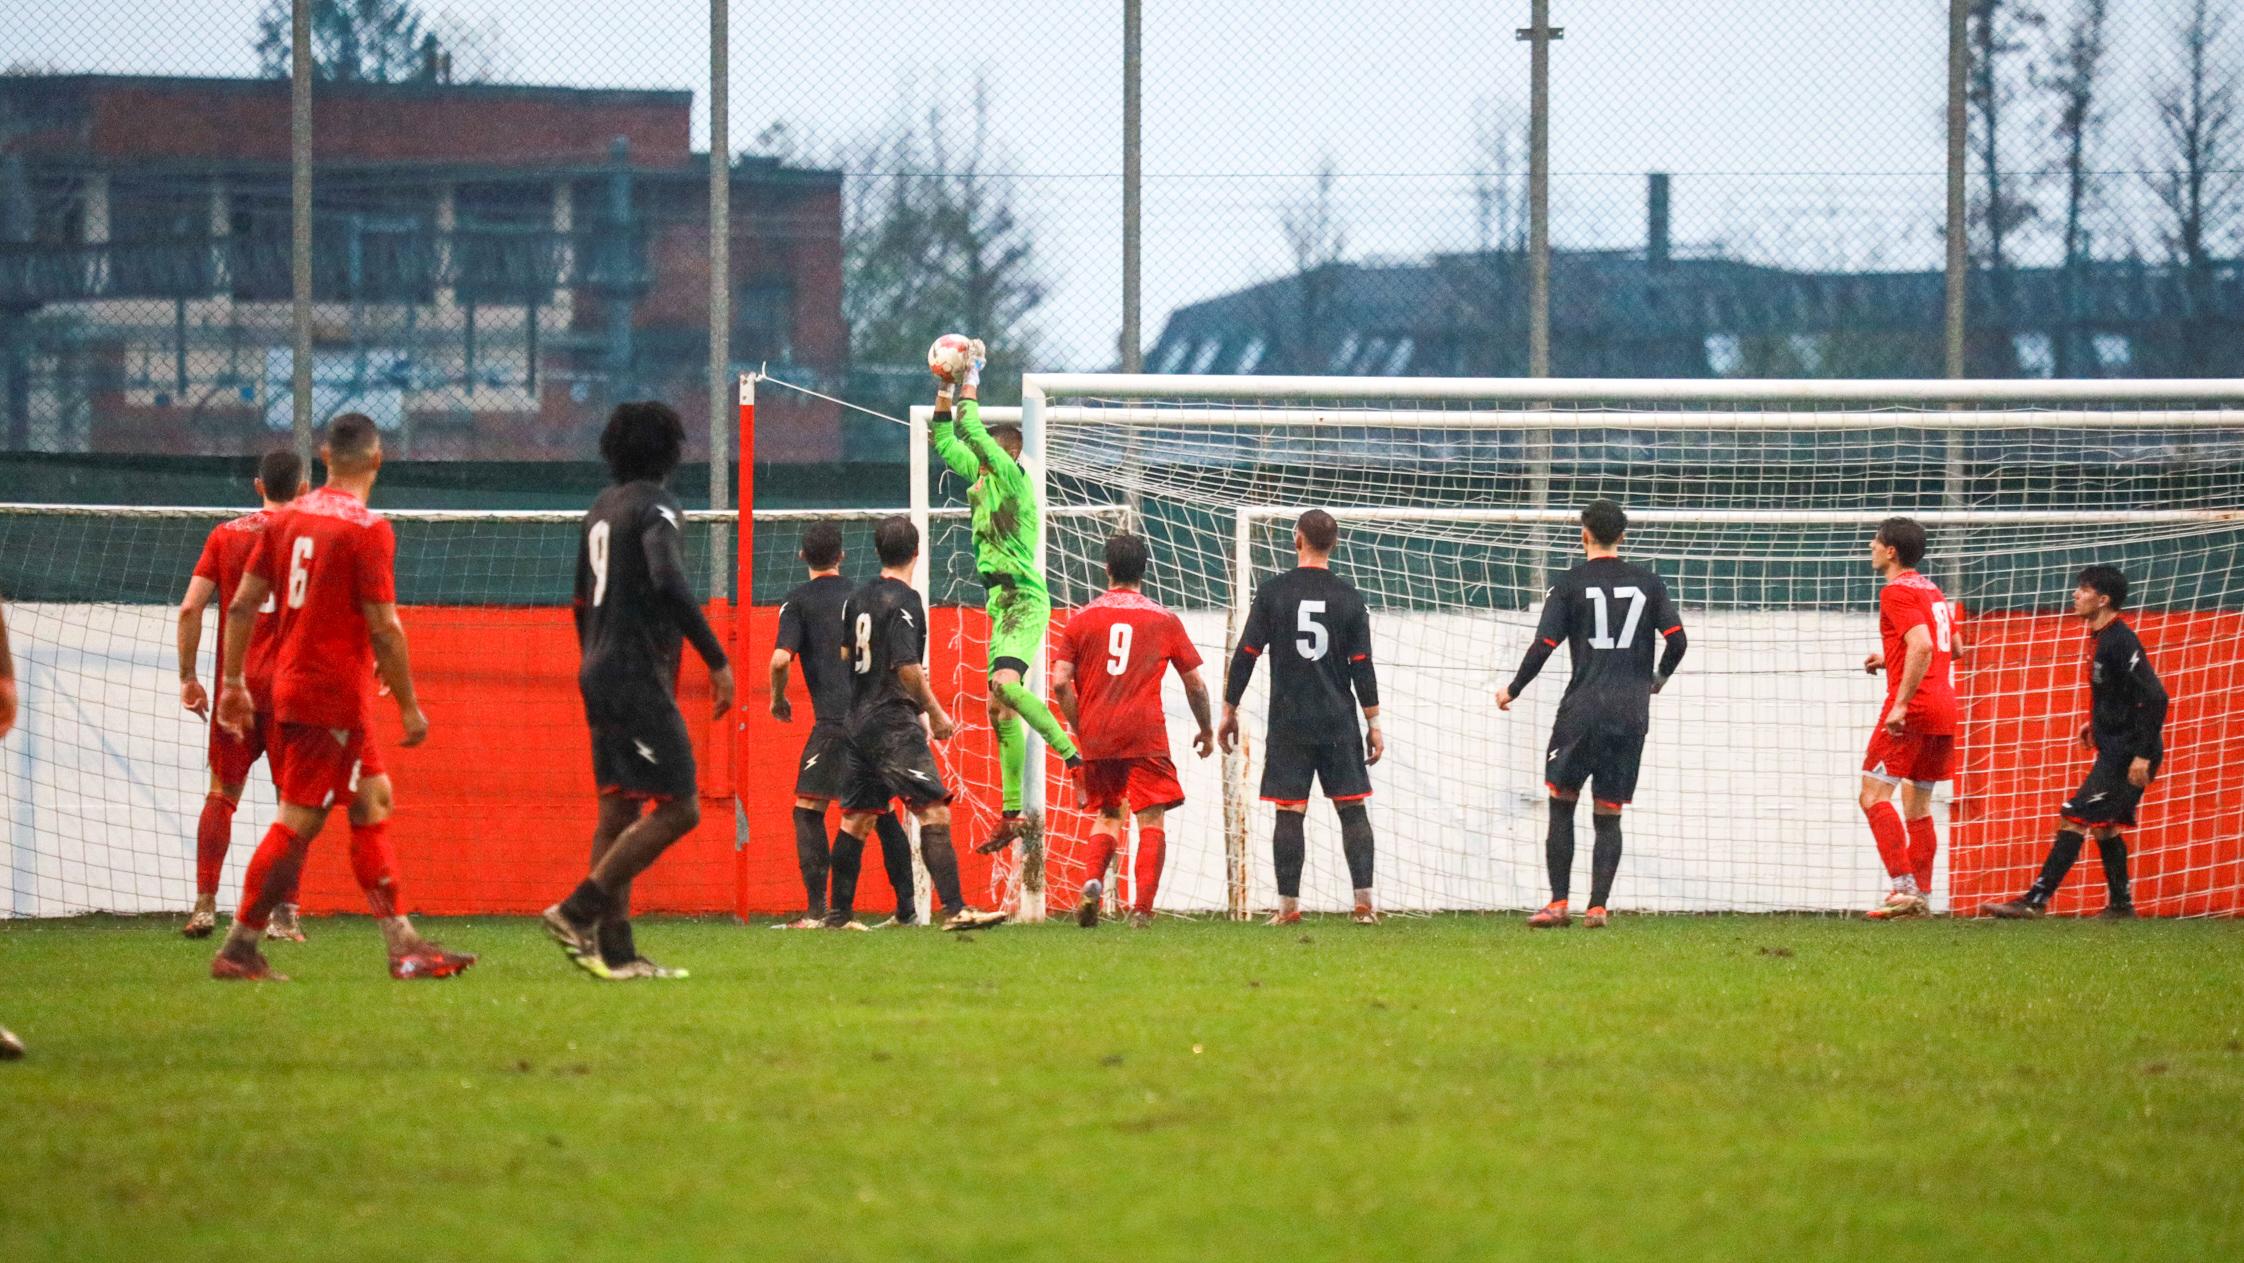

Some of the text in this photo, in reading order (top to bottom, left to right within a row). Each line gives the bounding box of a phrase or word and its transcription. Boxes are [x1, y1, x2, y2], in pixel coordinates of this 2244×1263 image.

[287, 535, 314, 609] 6
[588, 519, 610, 607] 9
[1106, 622, 1133, 676] 9
[1295, 599, 1329, 661] 5
[1585, 586, 1647, 649] 17
